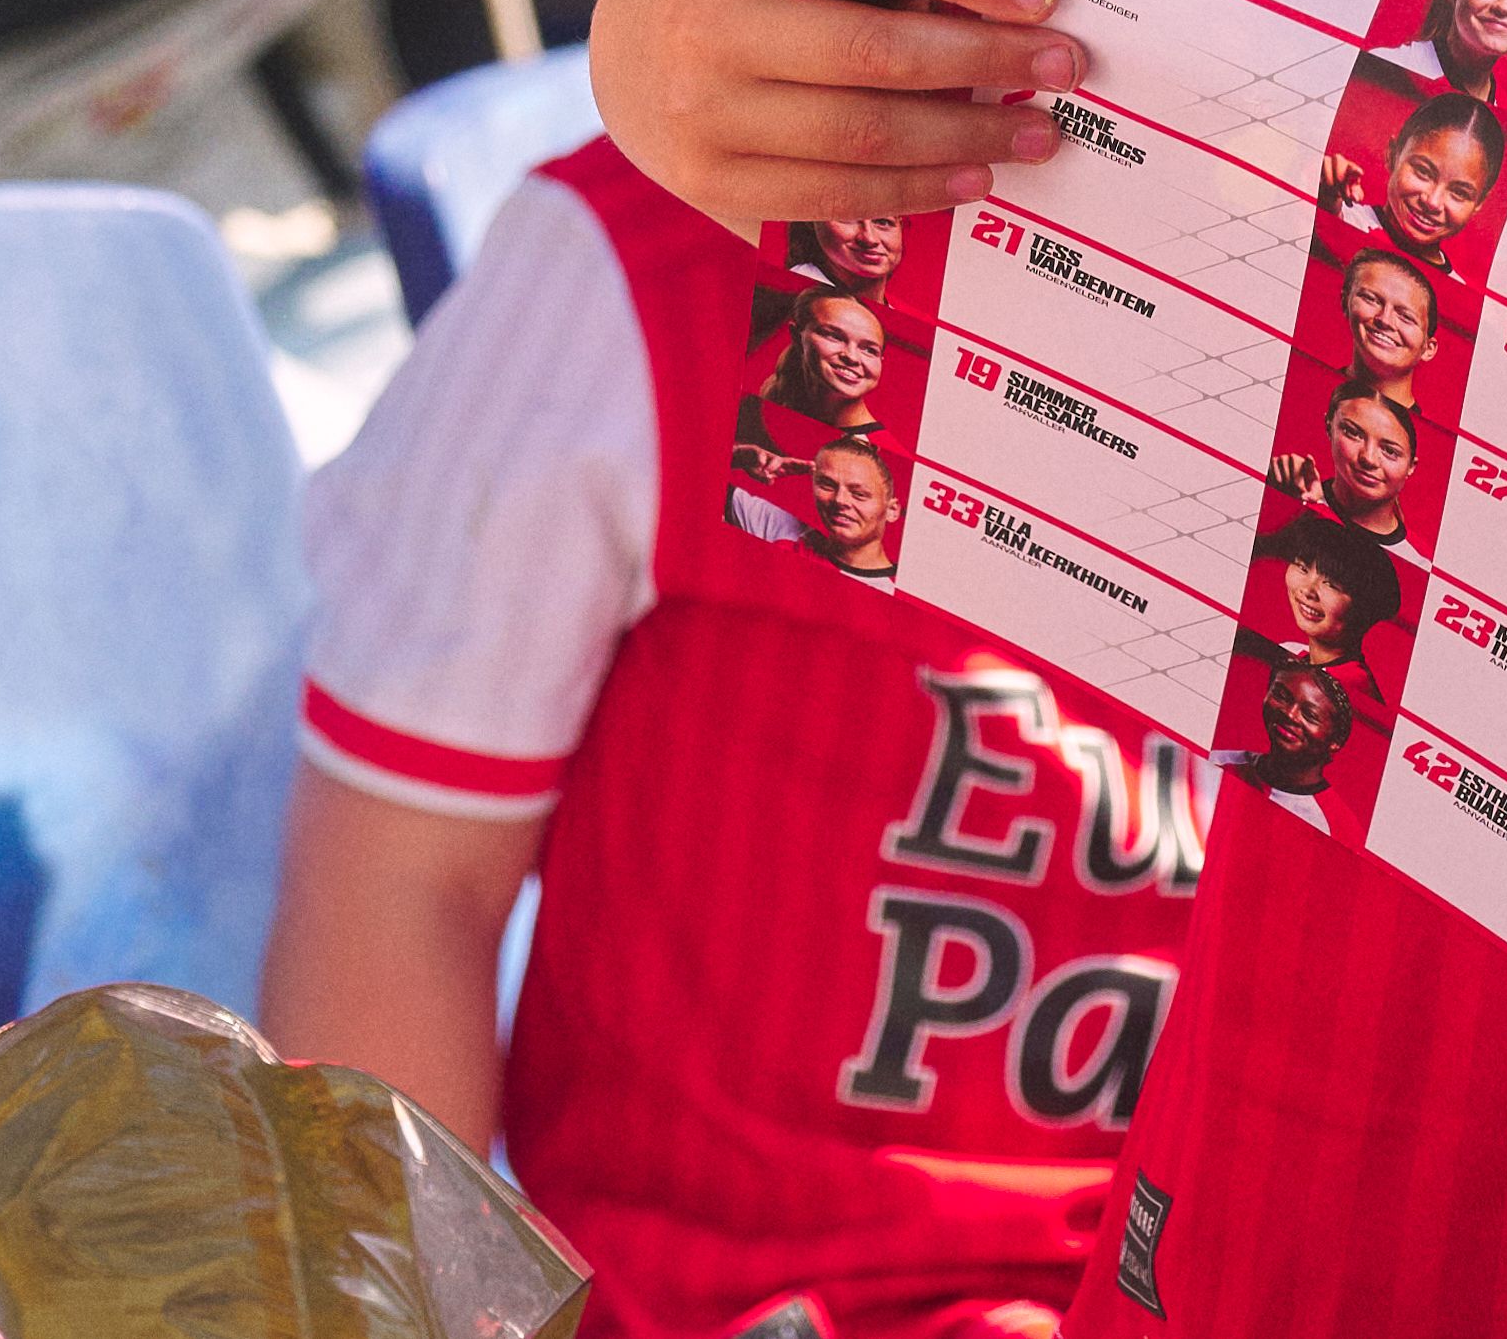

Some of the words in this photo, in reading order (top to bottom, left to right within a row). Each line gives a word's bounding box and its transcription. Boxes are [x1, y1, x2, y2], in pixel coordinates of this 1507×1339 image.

[1050, 97, 1117, 136] JARNE
[1060, 132, 1132, 169] DDENVELDER
[970, 210, 1026, 256] 21
[1032, 232, 1083, 267] TESS
[1026, 264, 1109, 308] MIDDENVELDER
[1029, 248, 1073, 282] VAN
[1072, 270, 1156, 319] BENTEM
[954, 346, 1002, 391] 19
[1003, 401, 1066, 434] AANVALLER
[1007, 370, 1098, 422] SUMMER
[1003, 385, 1139, 460] HAESAKKERS
[923, 480, 985, 529] 33
[984, 504, 1032, 539] ELLA
[981, 536, 1042, 569] AANVALLER
[984, 520, 1028, 552] VAN
[1027, 542, 1149, 614] KERKHOVEN
[1434, 595, 1496, 648] 23
[1403, 741, 1462, 793] 42
